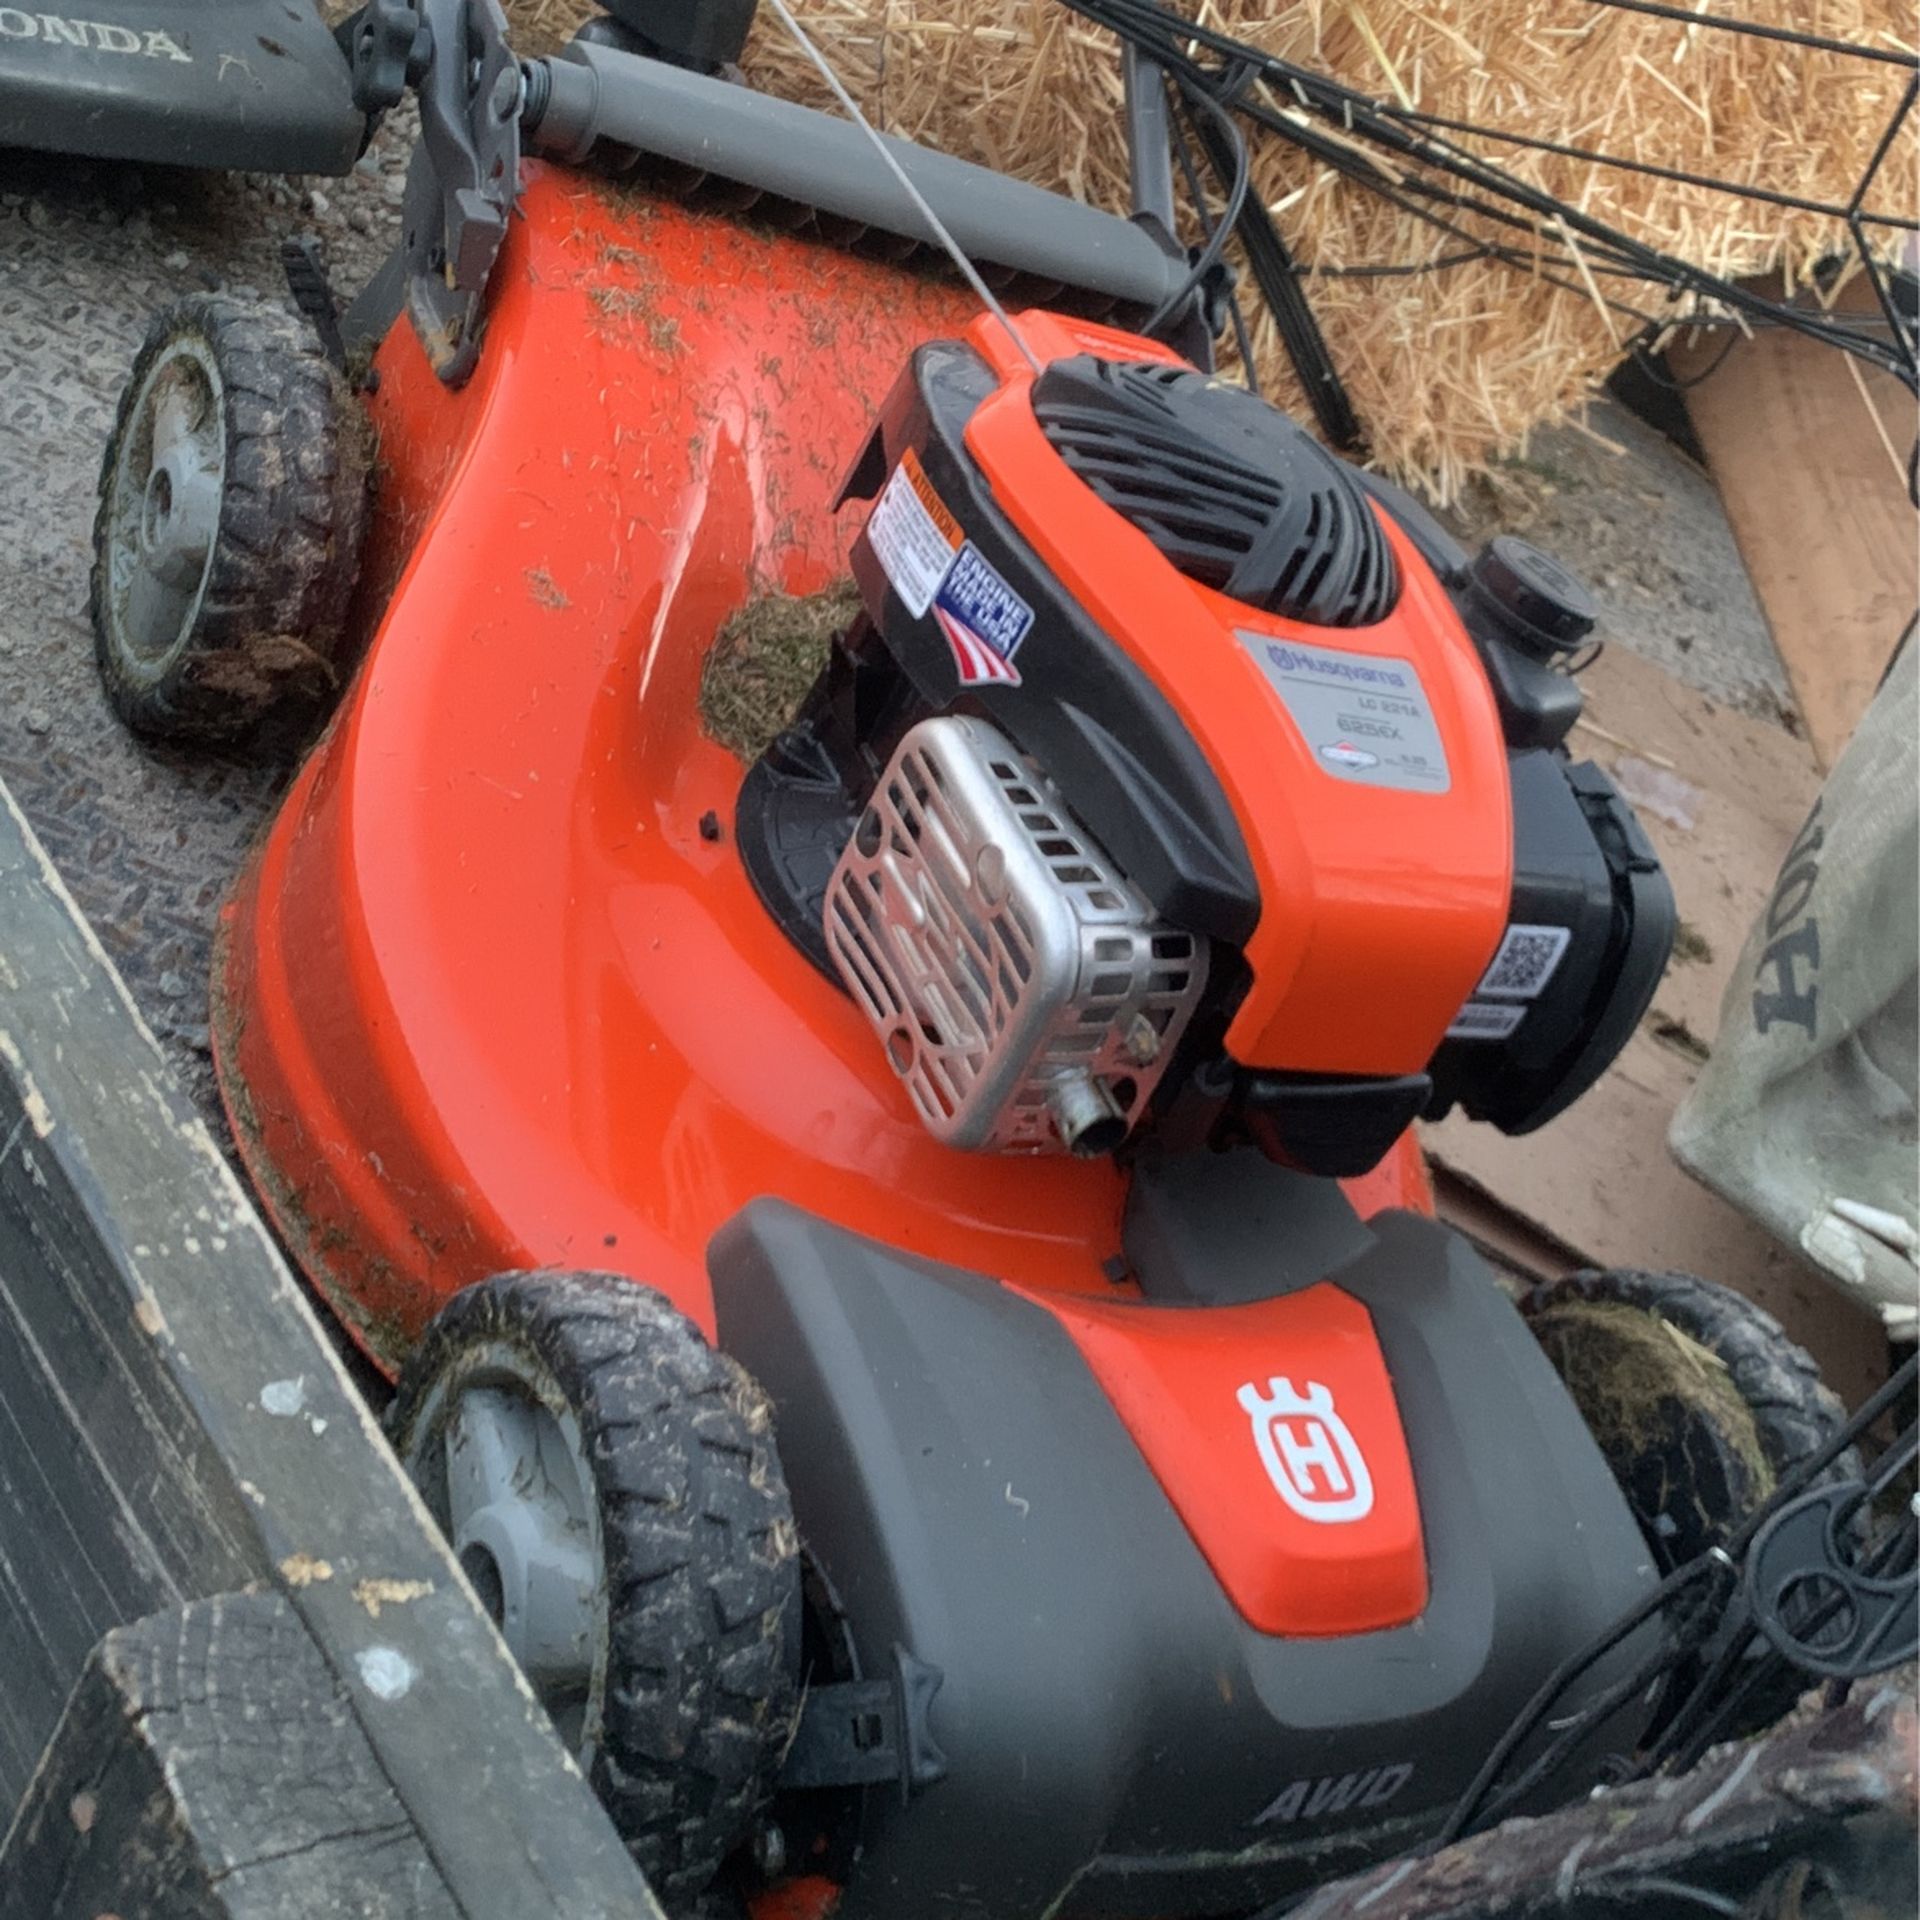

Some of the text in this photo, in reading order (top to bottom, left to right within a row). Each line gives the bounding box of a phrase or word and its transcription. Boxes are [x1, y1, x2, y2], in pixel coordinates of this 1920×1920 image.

[946, 577, 1010, 650] THE USA
[951, 562, 1021, 638] MADE IN
[960, 548, 1027, 622] ENGINE
[1291, 651, 1406, 687] Husqvarna
[1253, 1762, 1414, 1825] AWD
